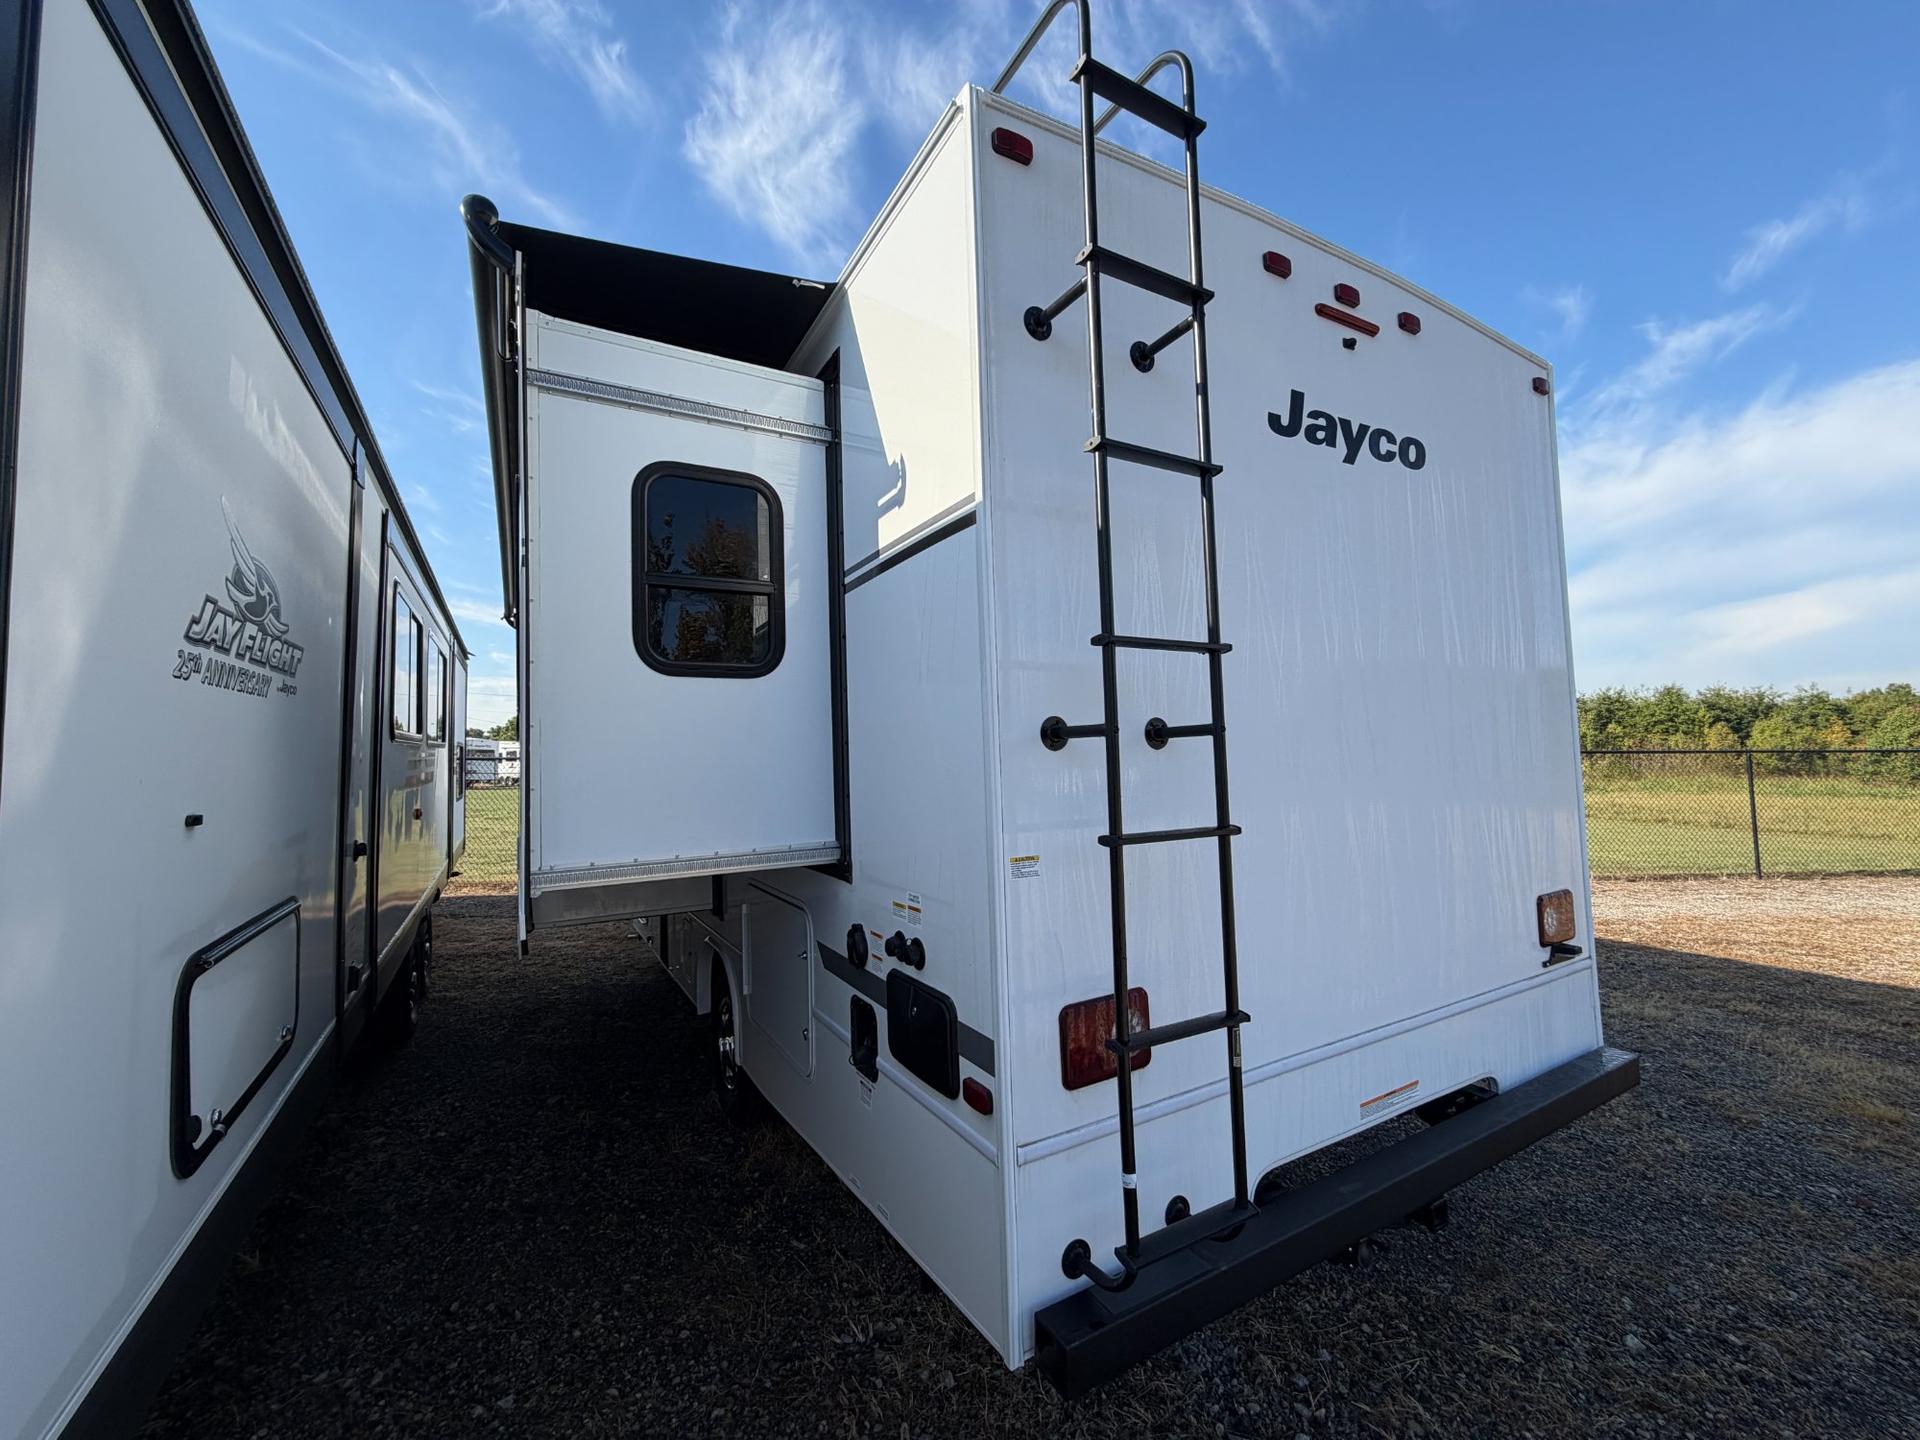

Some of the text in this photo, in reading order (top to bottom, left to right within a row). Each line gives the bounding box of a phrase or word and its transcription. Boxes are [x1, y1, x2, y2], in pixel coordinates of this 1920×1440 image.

[1267, 388, 1426, 470] Jayco
[201, 657, 273, 699] ANNIVERSARY
[276, 679, 298, 697] Jayco
